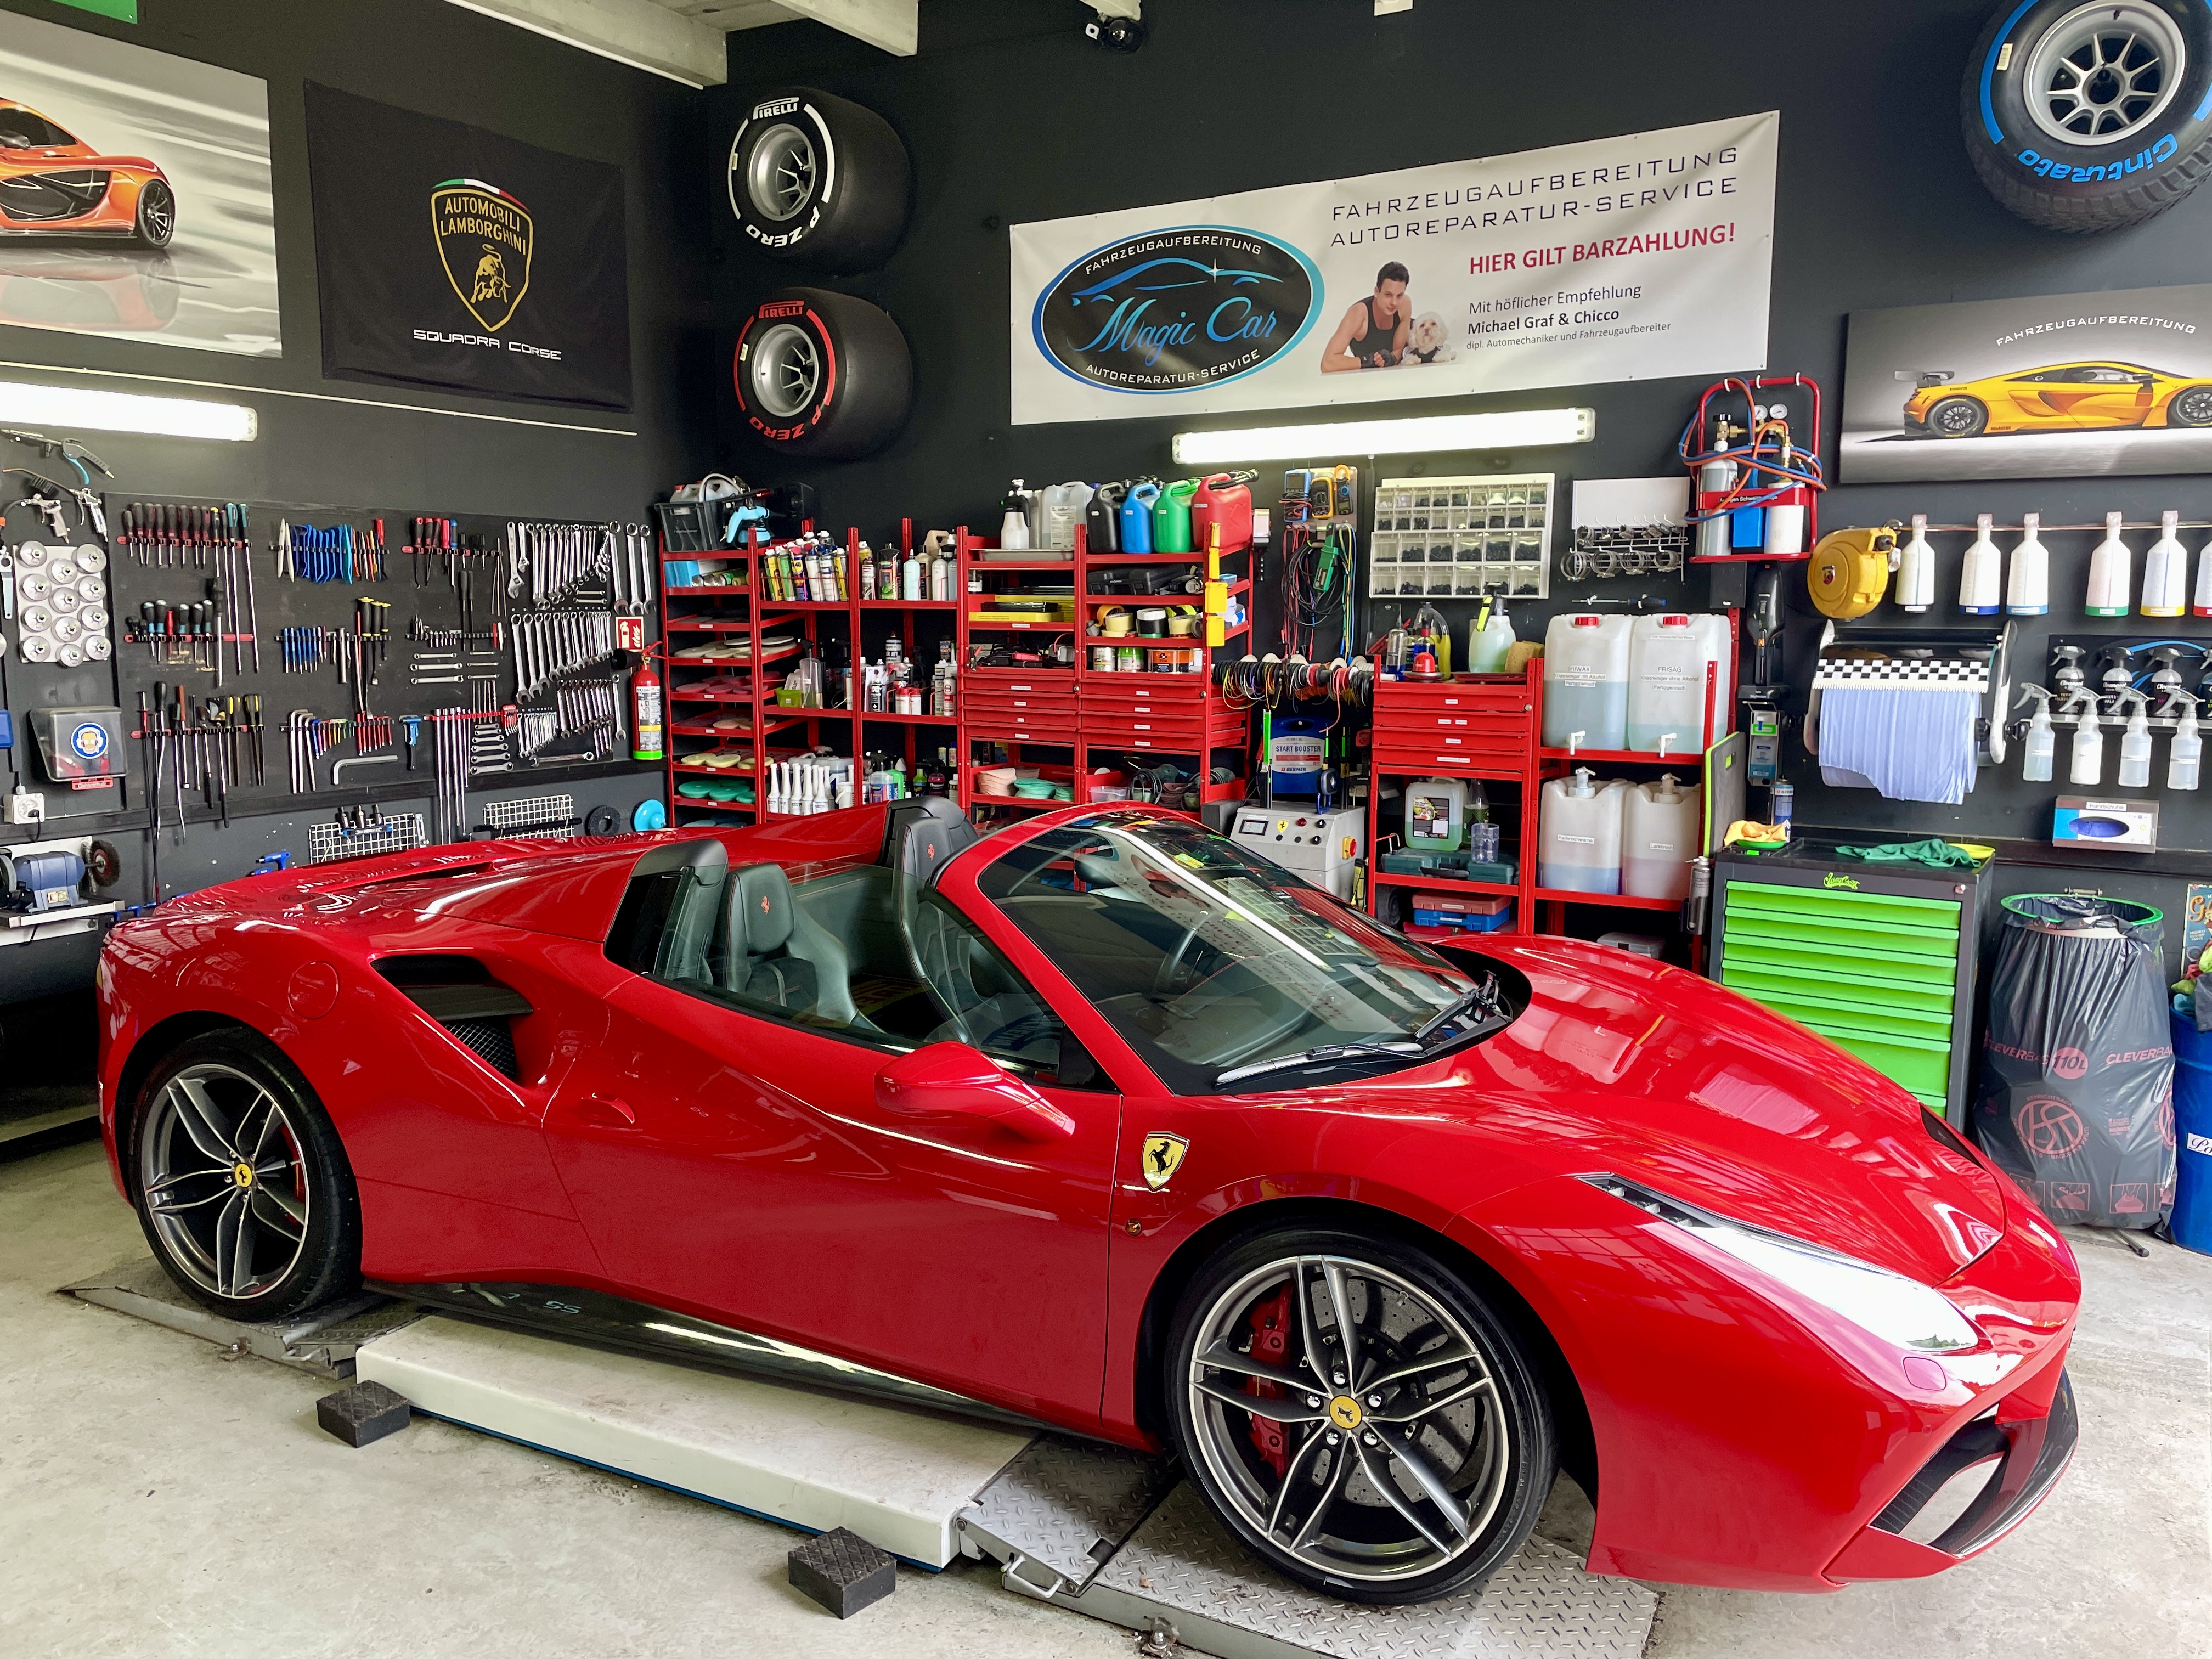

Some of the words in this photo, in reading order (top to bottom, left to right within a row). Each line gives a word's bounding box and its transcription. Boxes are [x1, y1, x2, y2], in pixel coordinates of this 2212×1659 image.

[752, 97, 800, 120] PIRELLI
[1333, 147, 1737, 221] FAHRZEUGAUFBEREITUNG
[445, 196, 520, 232] AUTOMOBILI
[809, 206, 820, 228] P
[1330, 177, 1737, 247] AUTOREPARATUR-SERVICE
[441, 217, 526, 256] LAMBORGHINI
[746, 224, 803, 247] ZERO
[1470, 252, 1516, 275] HIER
[1522, 246, 1566, 268] GILT
[1572, 222, 1736, 262] BARZAHLUNG!
[1086, 235, 1262, 275] FAHRZEUGAUFBEREITUNG
[759, 300, 805, 319] PIRELLI
[1470, 300, 1492, 314] Mit
[1495, 291, 1553, 312] höflicher
[1557, 283, 1642, 308] Empfehlung
[1066, 297, 1198, 366] Magic
[1207, 296, 1277, 342] Car
[1466, 340, 1485, 351] dipl.
[1487, 333, 1558, 348] Automechaniker
[1560, 331, 1577, 342] und
[1579, 321, 1671, 340] Fahrzeugaufbereiter
[1468, 318, 1520, 335] Michael
[1525, 314, 1556, 330] Graf
[1559, 313, 1570, 325] &
[1574, 308, 1620, 324] Chicco
[1996, 315, 2196, 347] FAHRZEUGAUFBEREITUNG
[413, 329, 500, 349] SQUADRA
[508, 341, 562, 360] CORSE
[1086, 348, 1260, 385] AUTOREPARATUR-SERVICE
[749, 416, 805, 440] ZERO
[811, 404, 821, 425] P
